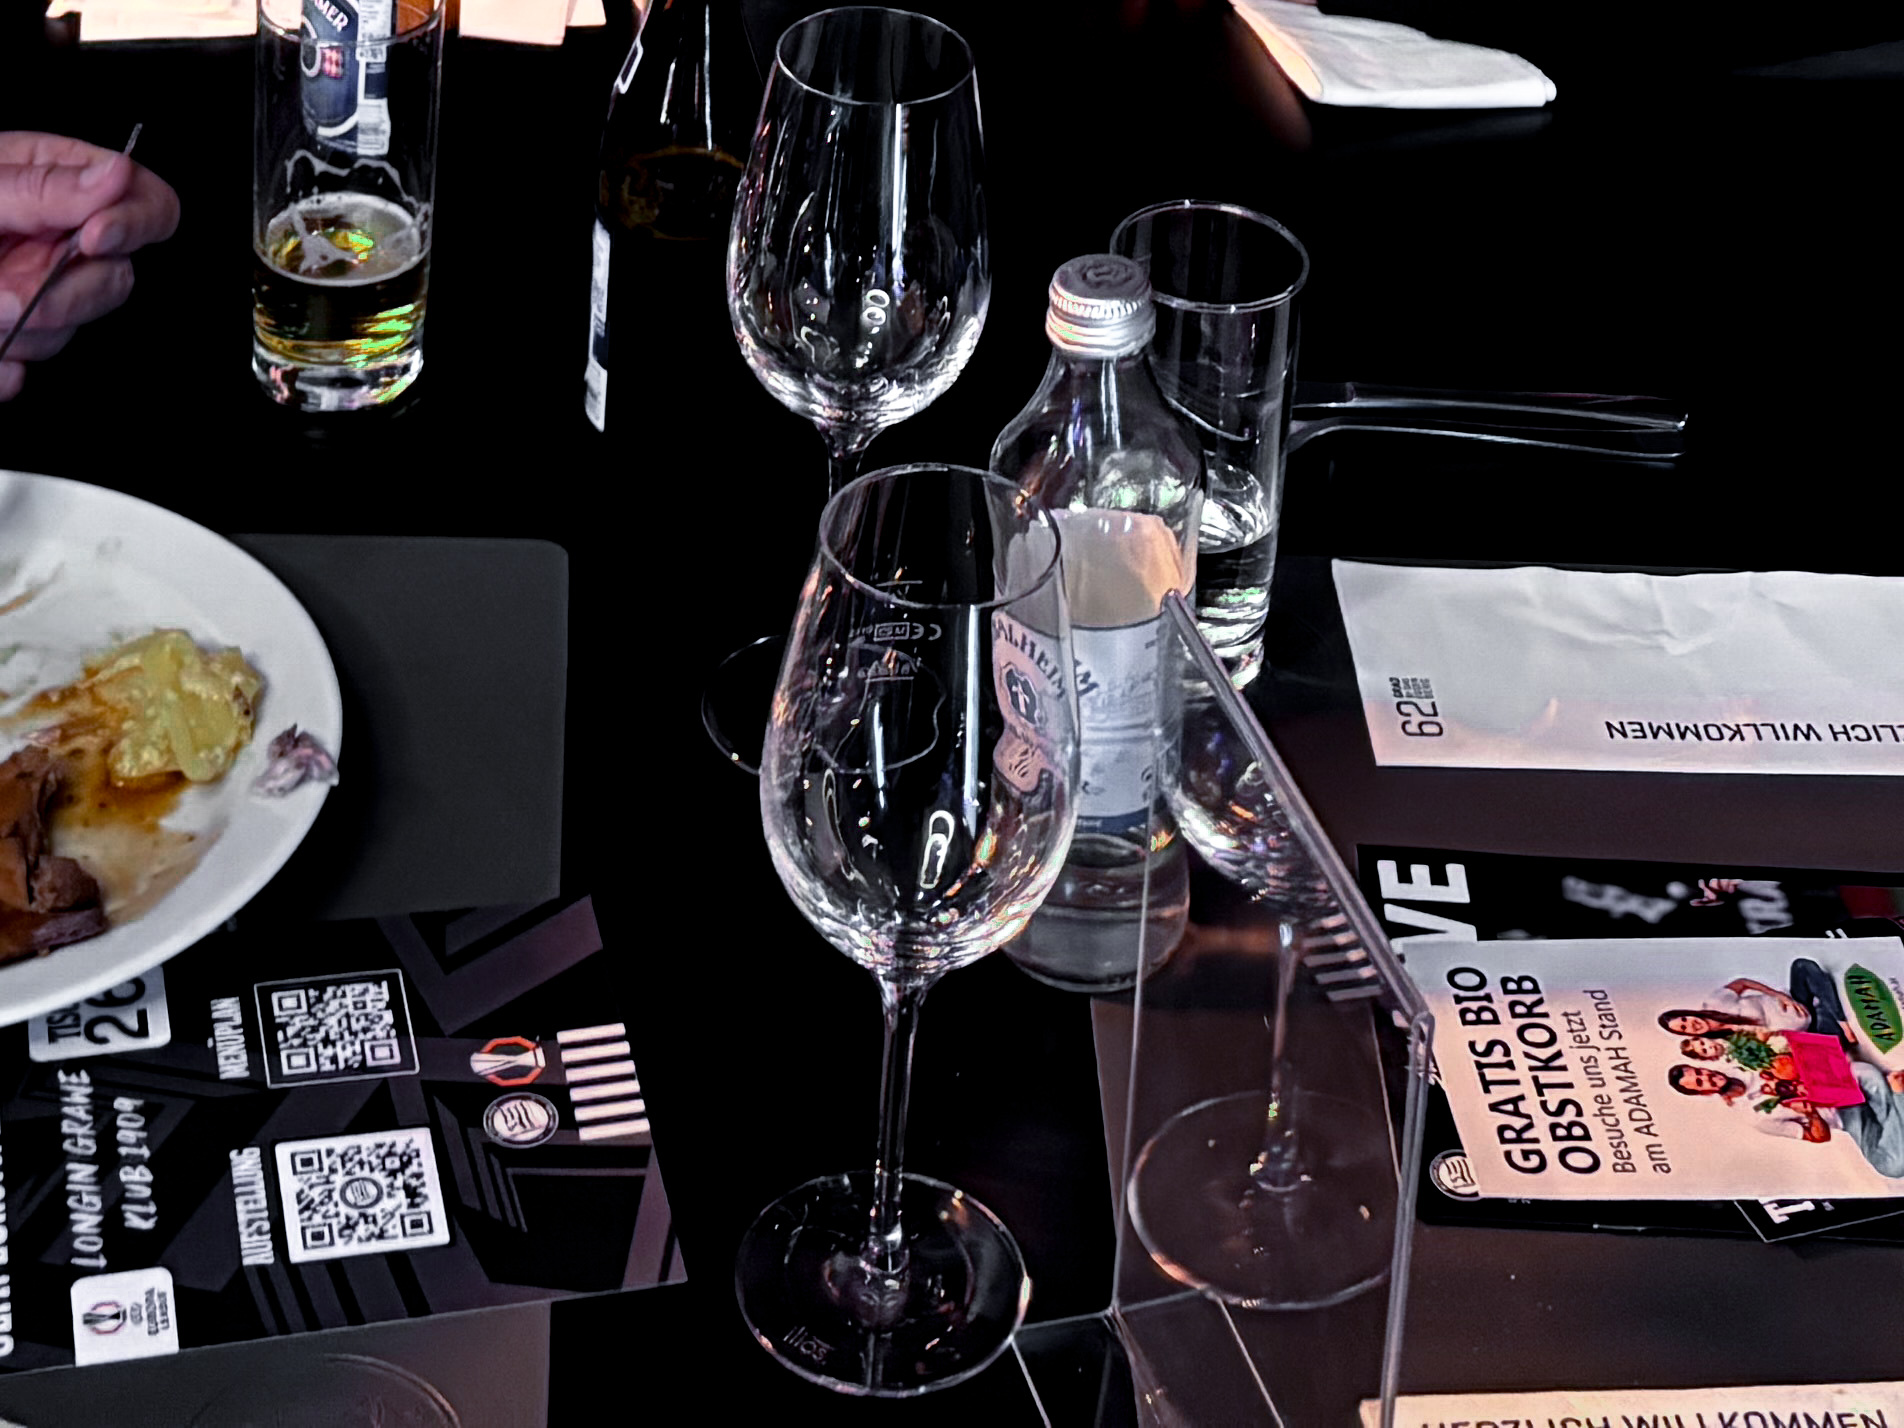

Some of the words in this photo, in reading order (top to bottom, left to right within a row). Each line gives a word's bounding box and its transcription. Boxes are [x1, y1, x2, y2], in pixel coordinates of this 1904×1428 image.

[1396, 701, 1443, 737] 62
[1604, 720, 1823, 742] WILLKOMMEN
[1447, 966, 1501, 1026] BIO
[1583, 989, 1623, 1041] Stand
[1847, 974, 1895, 1043] ADAMAH
[207, 997, 250, 1080] MENÜPLAN
[1561, 1010, 1602, 1052] jetzt
[1500, 975, 1601, 1175] OBSTKORB
[1580, 1055, 1606, 1089] uns
[1604, 1046, 1659, 1138] ADAMAH
[57, 1068, 97, 1156] GRAWE
[113, 1097, 150, 1161] 1909
[1468, 1039, 1548, 1175] GRATIS
[1592, 1093, 1637, 1174] Besuche
[1647, 1143, 1672, 1175] am
[65, 1162, 108, 1269] LONGIN
[119, 1164, 158, 1230] KLUB
[229, 1147, 274, 1266] AUFSTELLUNG
